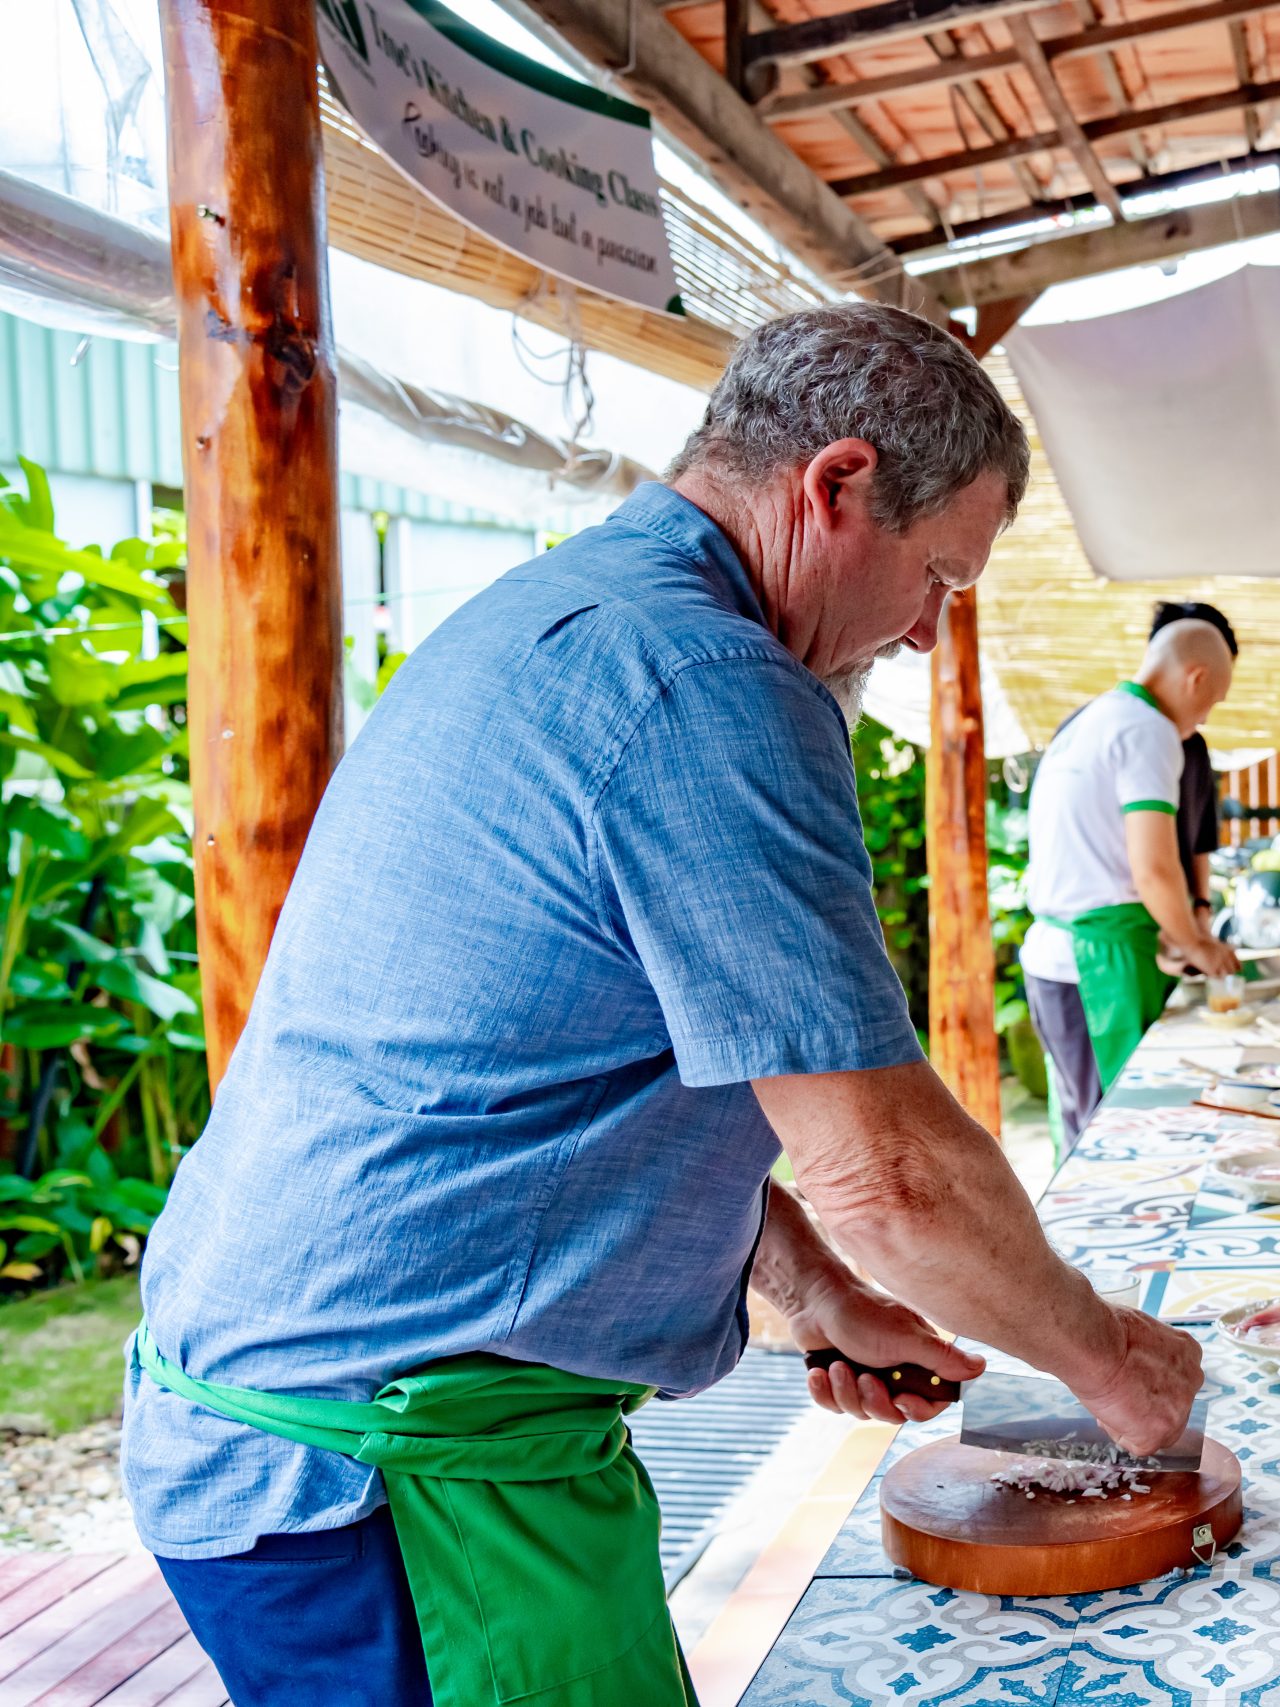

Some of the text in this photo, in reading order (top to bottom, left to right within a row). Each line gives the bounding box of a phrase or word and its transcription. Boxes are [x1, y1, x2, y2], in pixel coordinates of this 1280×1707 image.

[420, 58, 497, 143] Kitchen
[499, 115, 519, 155] &
[520, 128, 608, 208] Cooking
[608, 170, 659, 218] Class
[463, 160, 480, 191] is
[482, 173, 507, 209] not
[510, 194, 523, 217] a
[523, 187, 549, 232] job
[551, 203, 578, 246] but
[581, 228, 596, 248] a
[596, 234, 658, 274] passion
